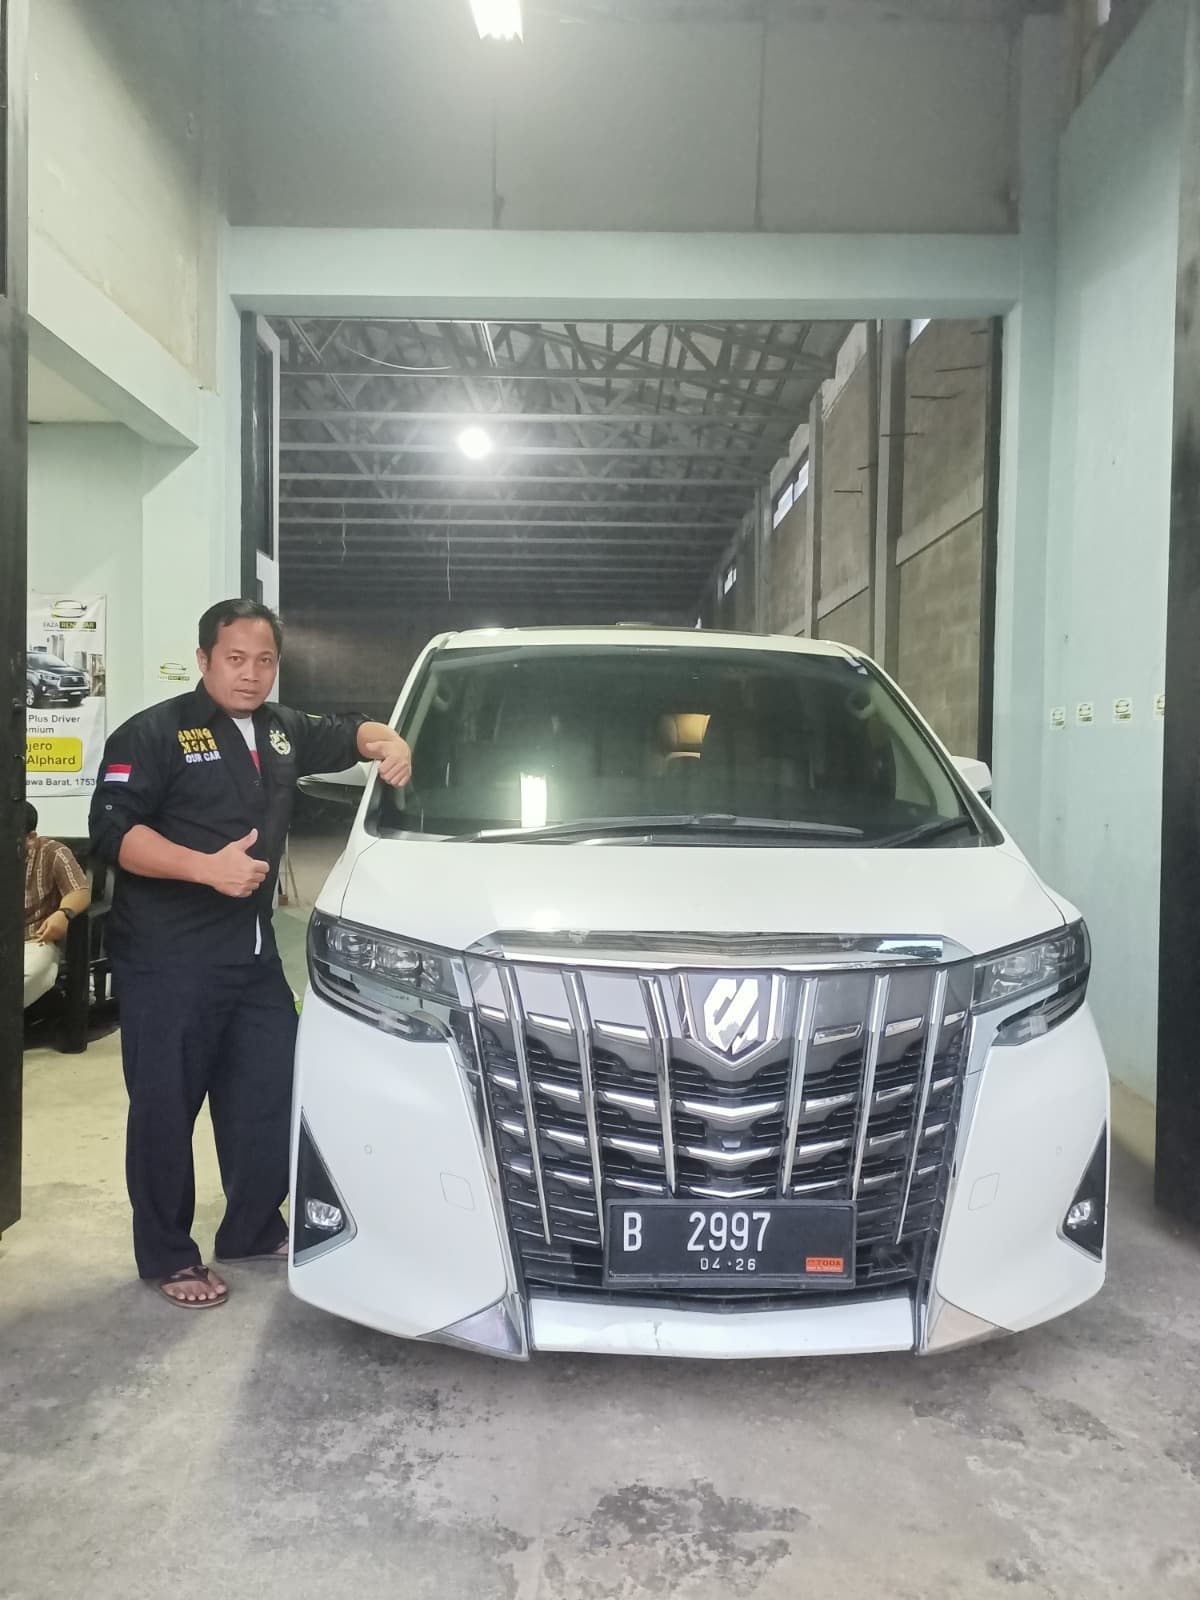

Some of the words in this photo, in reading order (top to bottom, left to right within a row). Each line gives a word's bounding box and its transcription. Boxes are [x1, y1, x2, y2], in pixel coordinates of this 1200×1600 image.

[28, 714, 49, 723] Plus
[51, 714, 81, 723] Driver
[26, 726, 55, 734] mium
[26, 742, 53, 753] jero
[26, 755, 76, 767] Alphard
[185, 753, 203, 764] OUR
[203, 750, 222, 762] CAR
[623, 1212, 642, 1252] B
[687, 1211, 771, 1252] 2997
